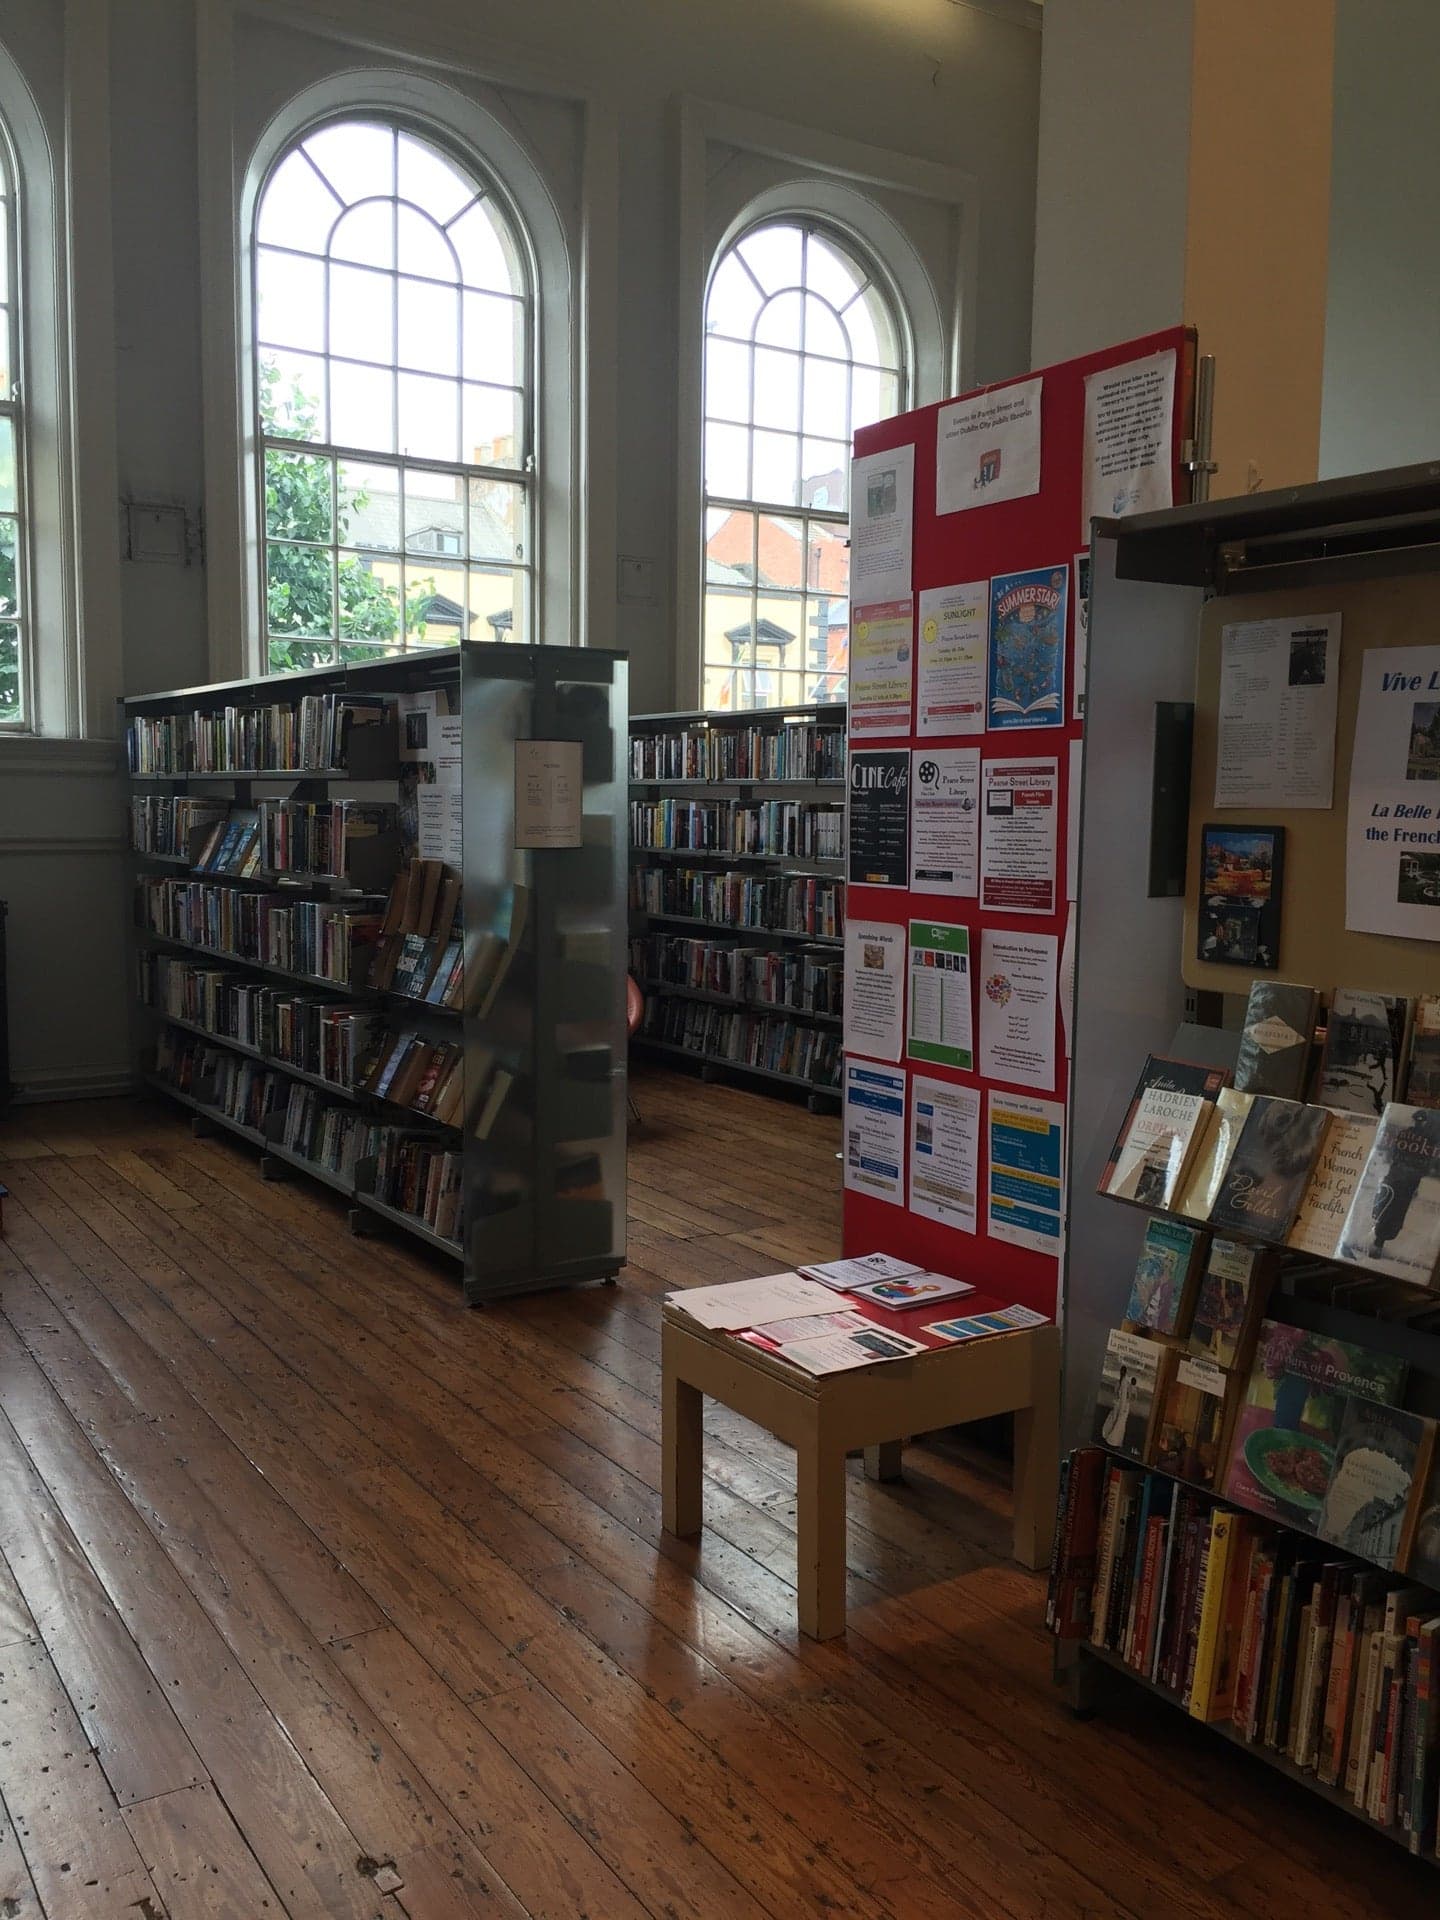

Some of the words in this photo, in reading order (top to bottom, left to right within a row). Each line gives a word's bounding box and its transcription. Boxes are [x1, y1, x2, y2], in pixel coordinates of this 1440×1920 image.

[998, 588, 1037, 618] SUMMER
[944, 608, 976, 620] SUNLIGHT
[888, 680, 908, 690] Library
[1381, 671, 1422, 692] Vive
[851, 764, 884, 788] CINE
[988, 778, 1008, 787] Pearse
[1010, 777, 1028, 786] Street
[1030, 776, 1050, 787] Library
[1371, 803, 1390, 818] La
[1394, 804, 1432, 819] Belle
[1366, 826, 1388, 842] the
[1148, 1090, 1198, 1108] HADRIEN
[1144, 1104, 1194, 1122] LAROCHE
[1138, 1120, 1188, 1138] ORPHANS
[1330, 1142, 1363, 1161] French
[1324, 1156, 1357, 1177] Women
[1334, 1180, 1352, 1198] Get
[1307, 1194, 1345, 1218] Facelifts
[1310, 1361, 1323, 1374] of
[1324, 1364, 1386, 1394] Provence
